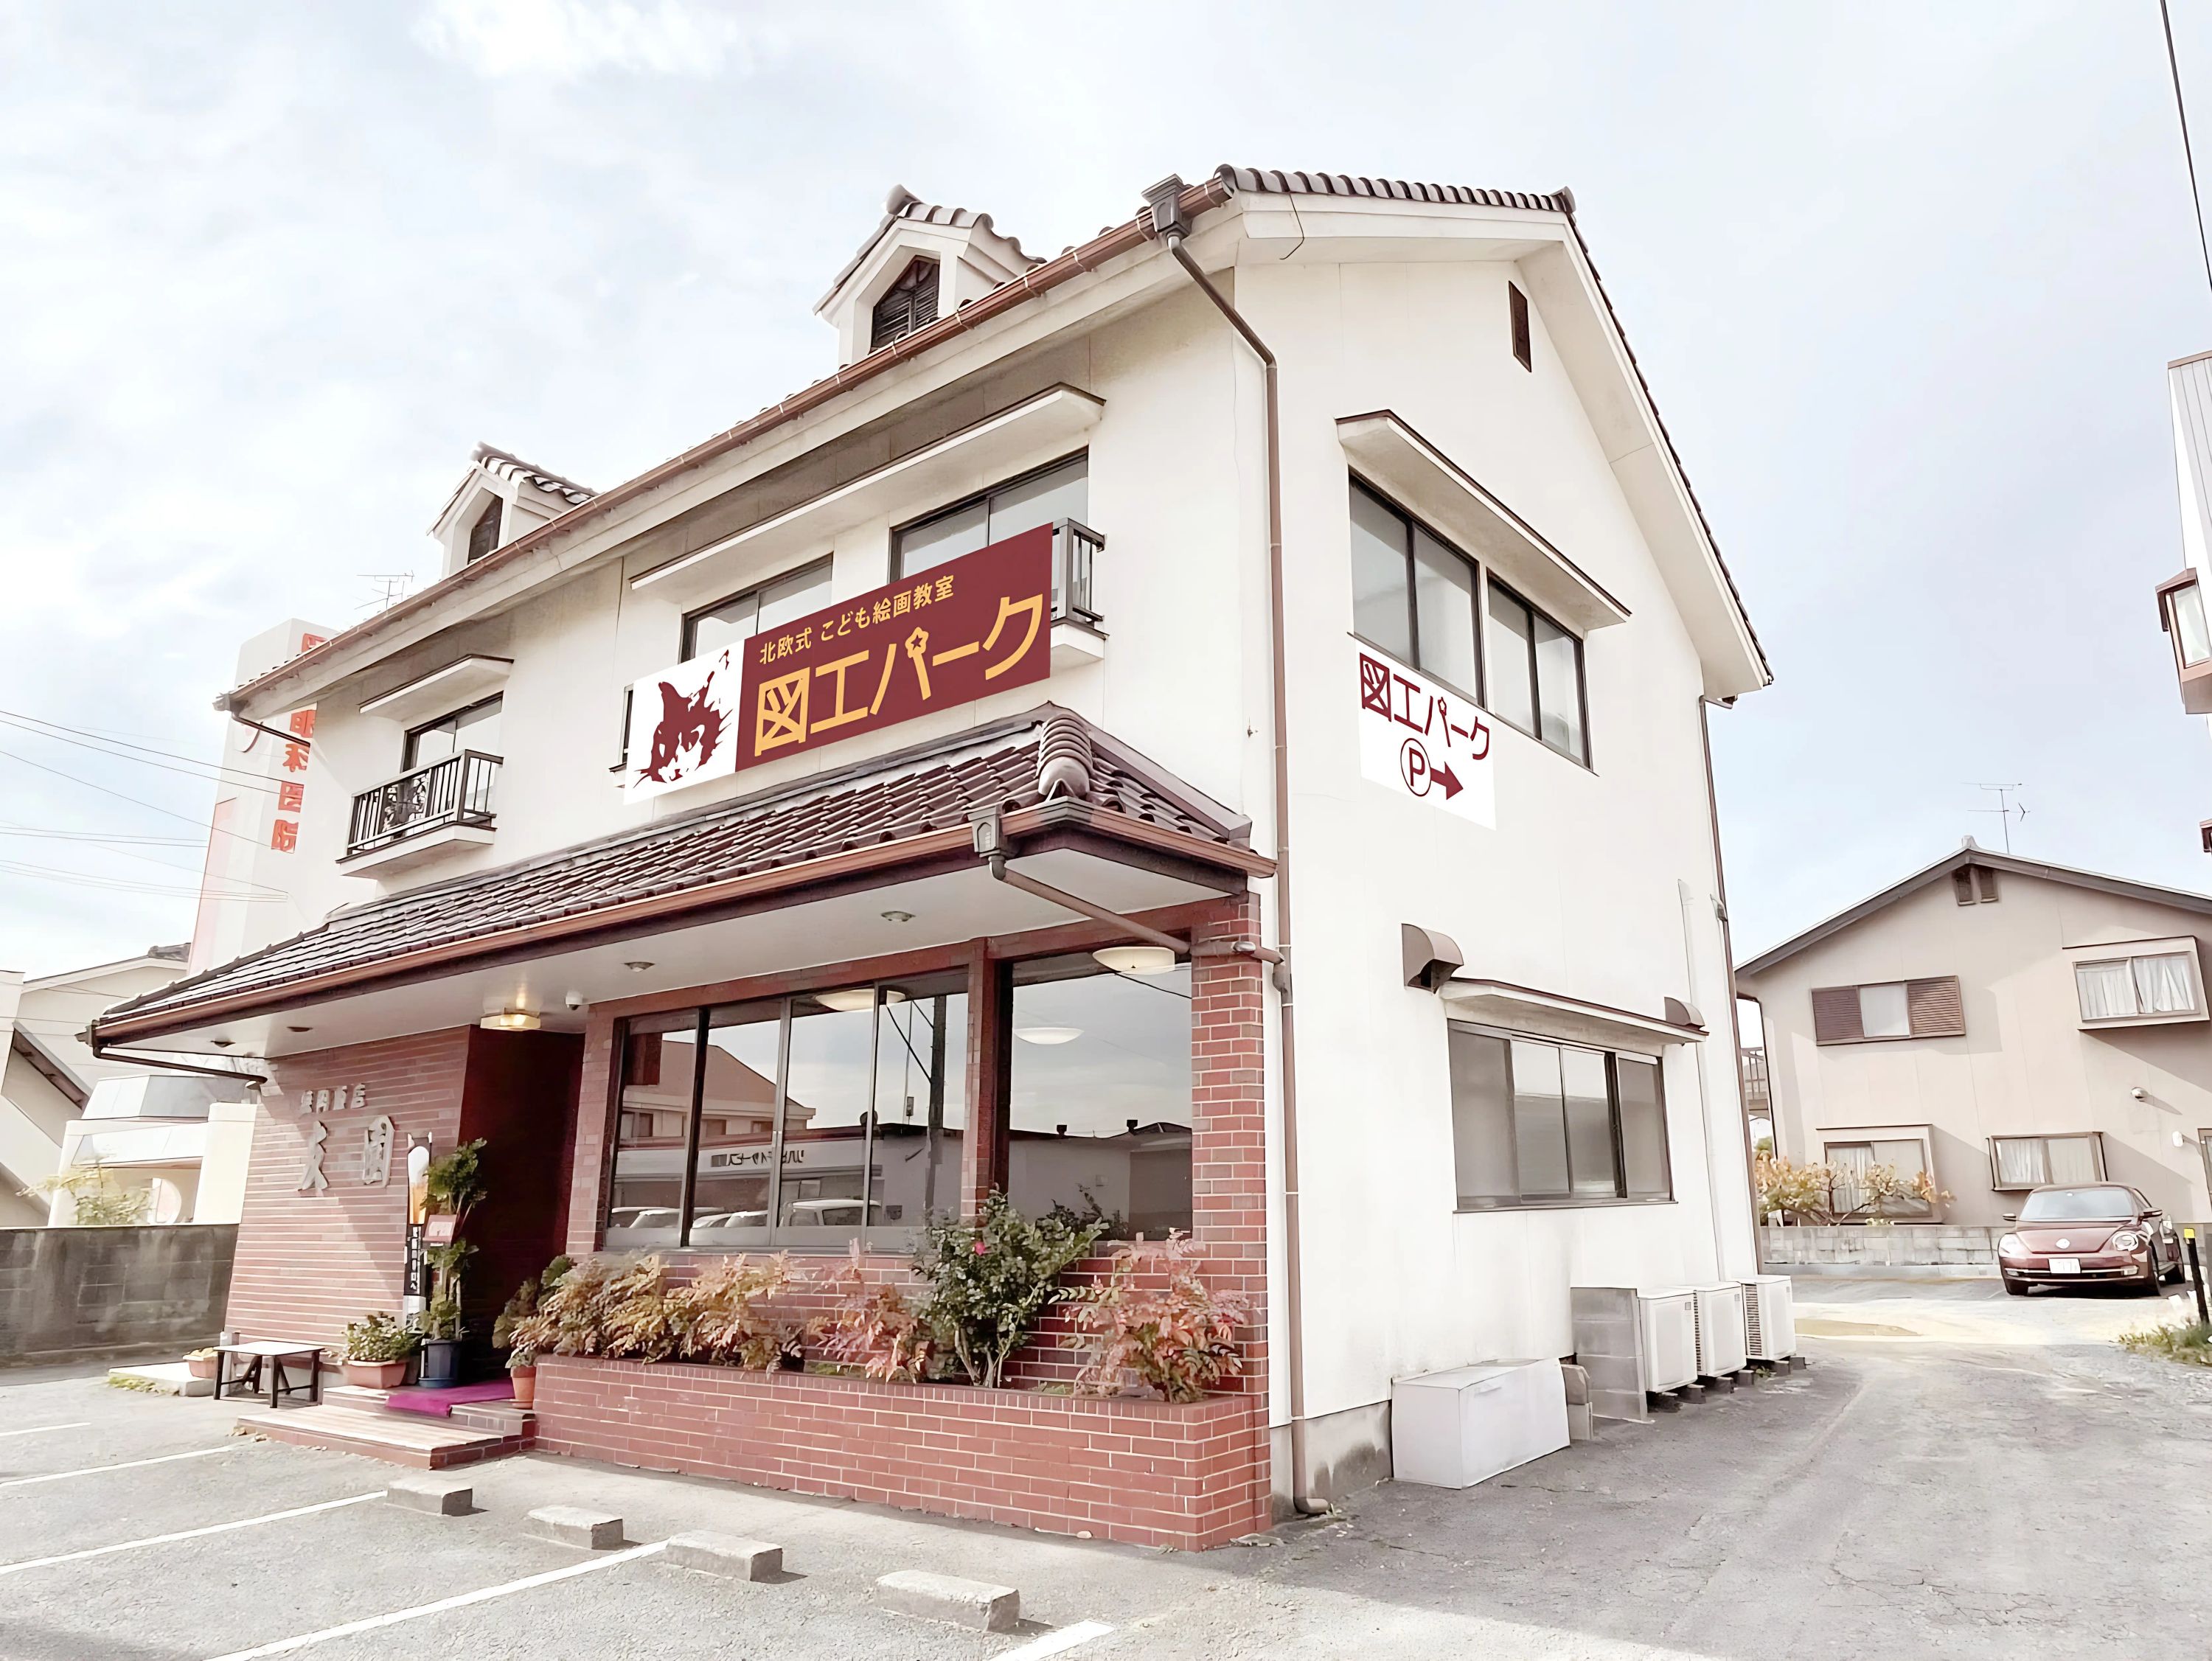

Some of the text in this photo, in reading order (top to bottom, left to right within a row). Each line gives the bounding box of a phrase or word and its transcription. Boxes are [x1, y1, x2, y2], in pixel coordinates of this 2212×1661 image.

[759, 574, 954, 664] 北欧式 こども絵画教室
[754, 593, 1043, 757] 図工パーク
[1359, 652, 1489, 760] 図工パーク
